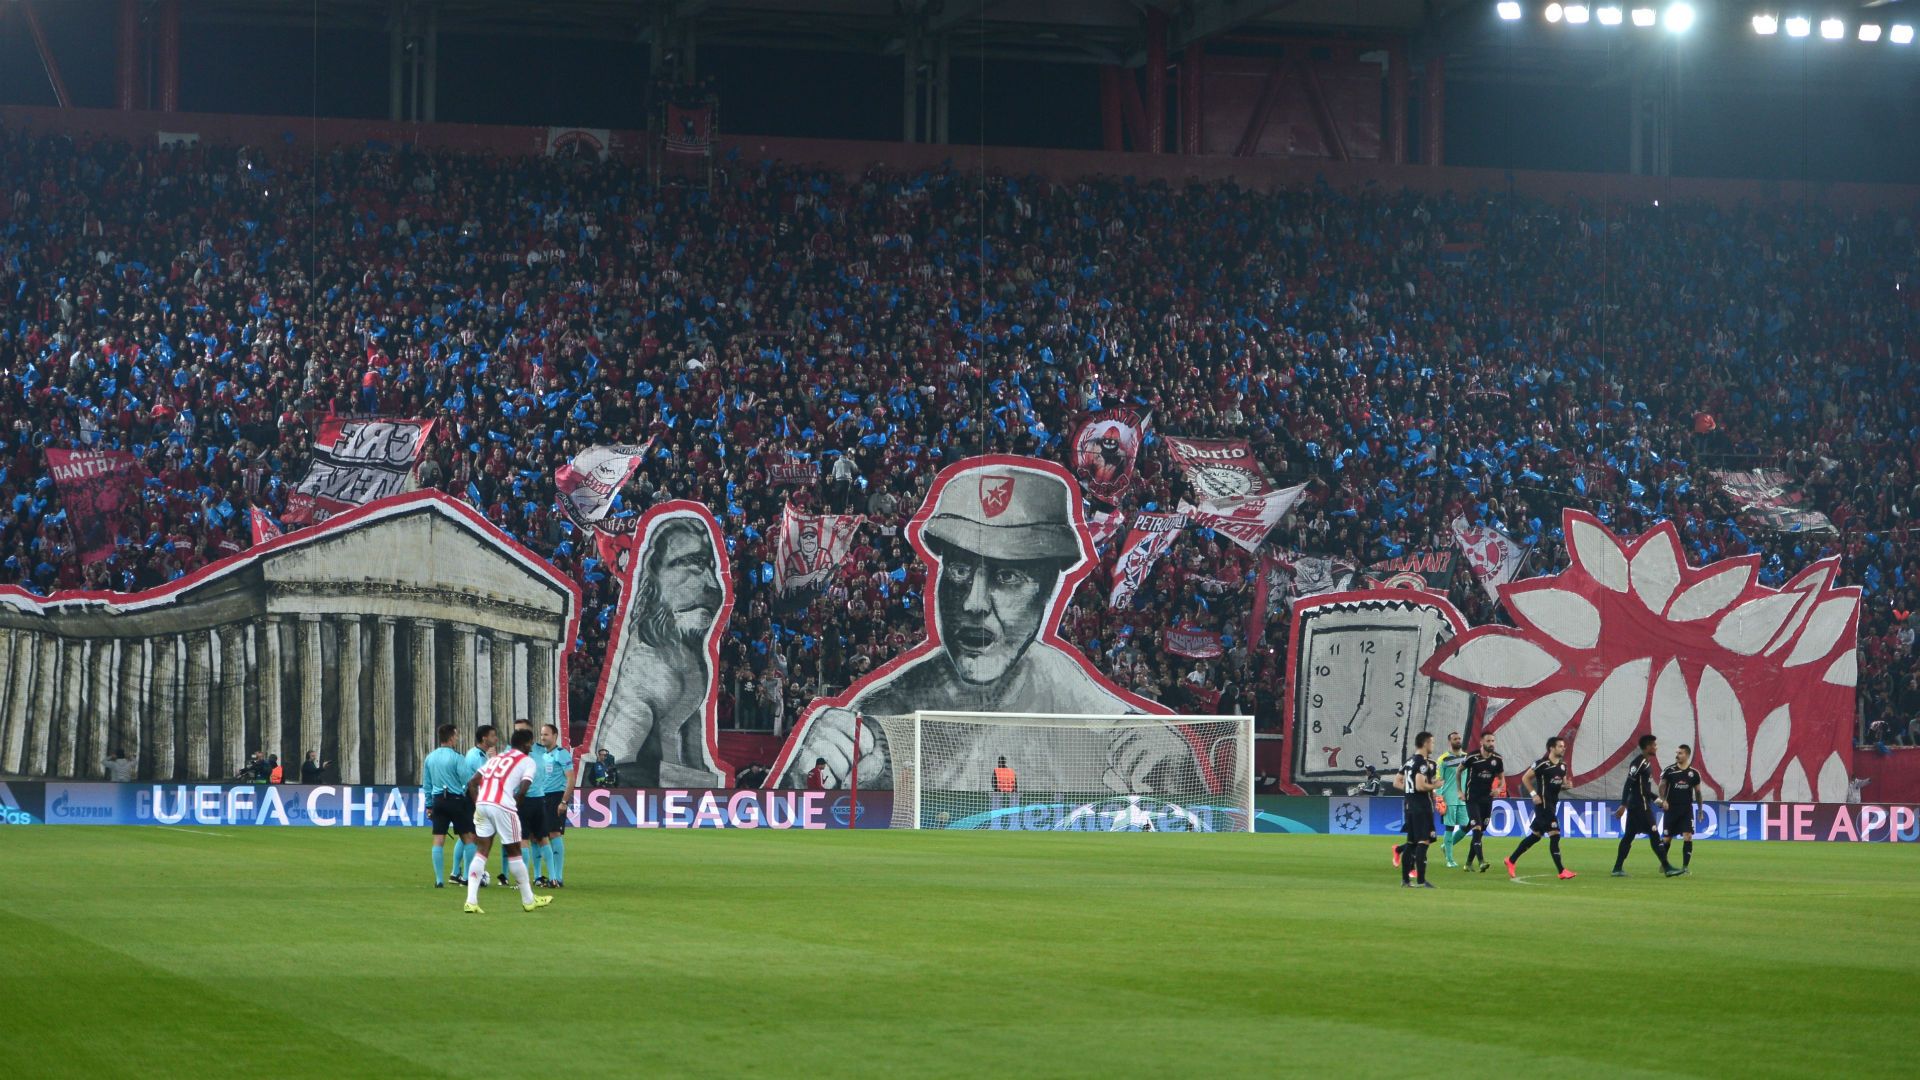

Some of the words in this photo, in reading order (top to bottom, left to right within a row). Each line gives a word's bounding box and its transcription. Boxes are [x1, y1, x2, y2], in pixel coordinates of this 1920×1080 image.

[1174, 441, 1245, 459] Porto
[1330, 644, 1340, 655] 11
[1360, 640, 1376, 654] 12
[1396, 651, 1402, 663] 1
[1315, 666, 1330, 676] 10
[1394, 672, 1405, 688] 2
[1312, 694, 1323, 708] 9
[1394, 702, 1404, 717] 3
[1312, 720, 1323, 733] 8
[1390, 726, 1399, 742] 4
[1322, 746, 1342, 768] 7
[1355, 755, 1365, 768] 6
[1380, 751, 1389, 765] 5
[483, 755, 514, 778] 99
[69, 807, 112, 817] GAZPROM
[152, 785, 290, 825] UEFA
[636, 790, 827, 829] LEAGUE
[1729, 804, 1816, 841] THE
[1828, 805, 1915, 842] APP
